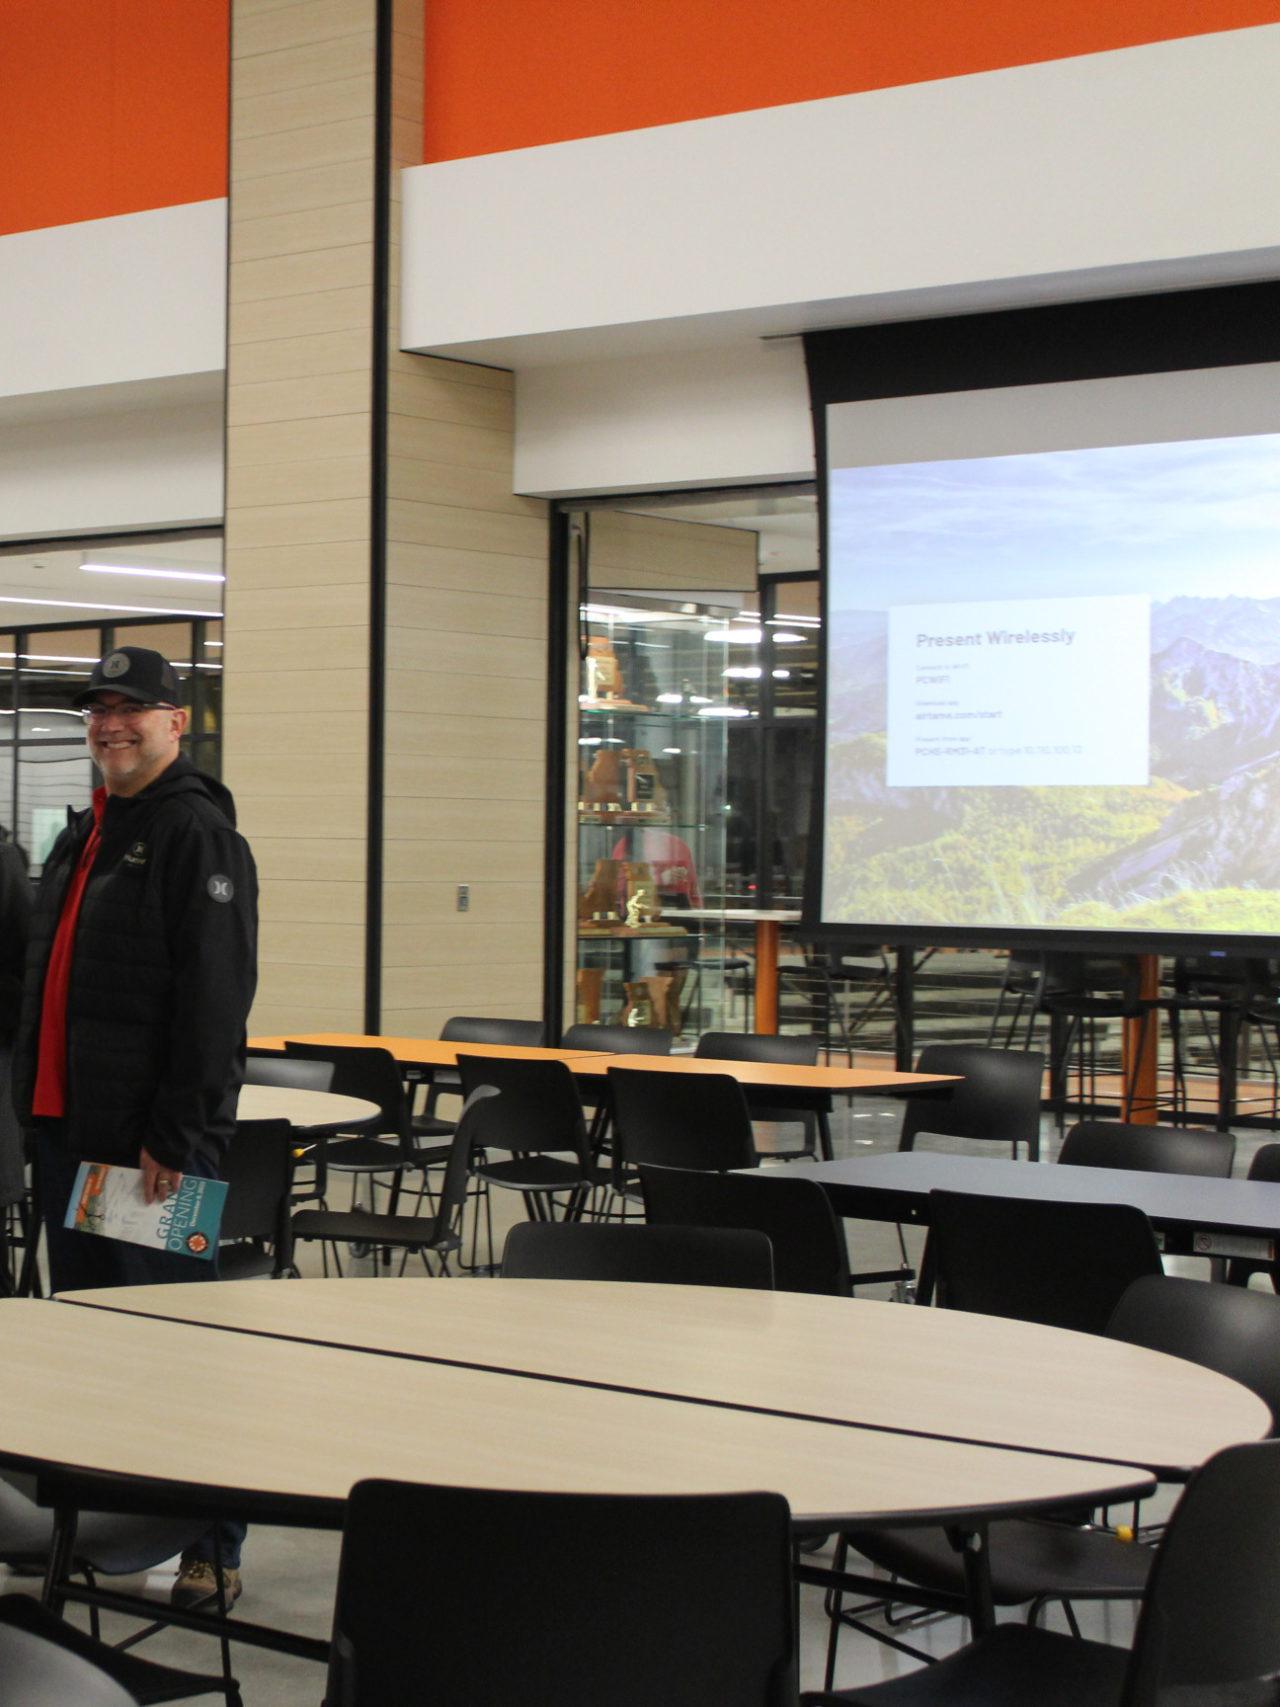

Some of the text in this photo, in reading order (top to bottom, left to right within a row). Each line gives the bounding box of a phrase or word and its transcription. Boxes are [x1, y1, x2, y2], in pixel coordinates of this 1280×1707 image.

[916, 627, 1076, 648] Present Wirelessly
[156, 1189, 178, 1239] GRAN
[168, 1179, 197, 1250] OPENING
